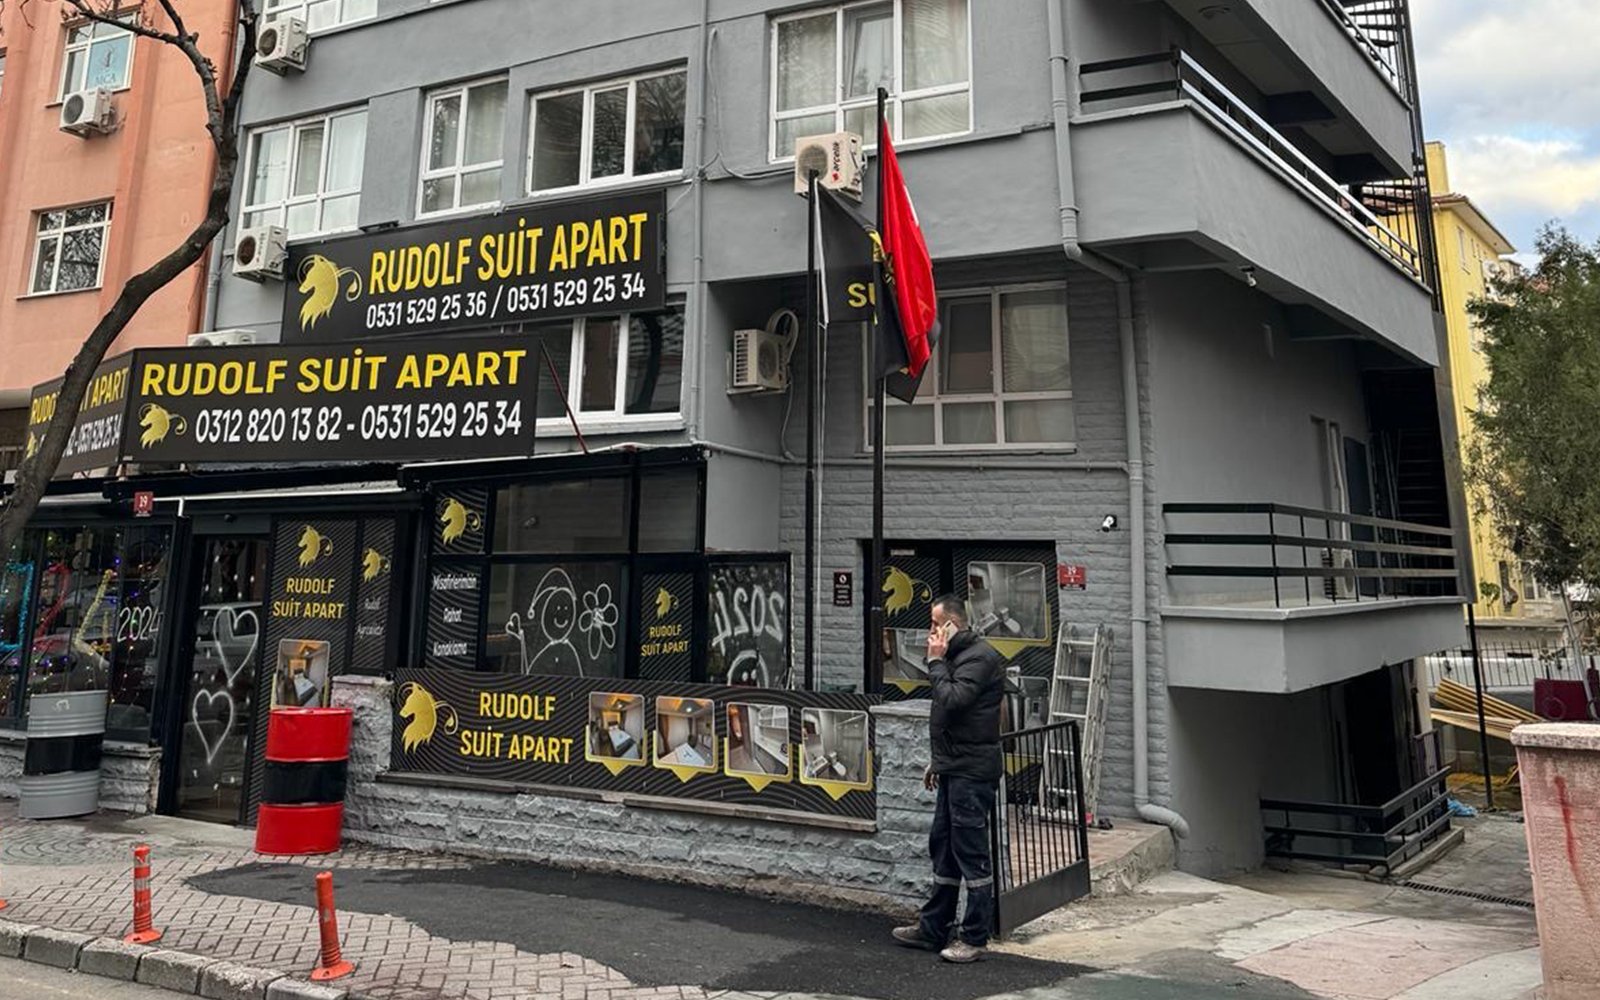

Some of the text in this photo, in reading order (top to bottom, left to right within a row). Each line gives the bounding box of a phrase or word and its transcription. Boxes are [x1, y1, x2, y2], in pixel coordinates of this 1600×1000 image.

[369, 212, 648, 295] RUDOLF SUİT APART
[366, 272, 646, 329] 0531 529 25 36 / 0531 529 25 34
[140, 347, 527, 396] RUDOLF SUİT APART
[29, 391, 60, 425] RUDO
[91, 367, 129, 408] APART
[195, 400, 522, 443] 0312 820 13 82 - 0531 529 25 34
[286, 578, 335, 594] RUDOLF
[117, 606, 163, 643] 2024
[272, 597, 345, 619] SUİT APART
[649, 624, 682, 638] RUDOLF
[662, 640, 689, 654] APART
[480, 691, 556, 720] RUDOLF
[460, 725, 573, 764] SUİT APART
